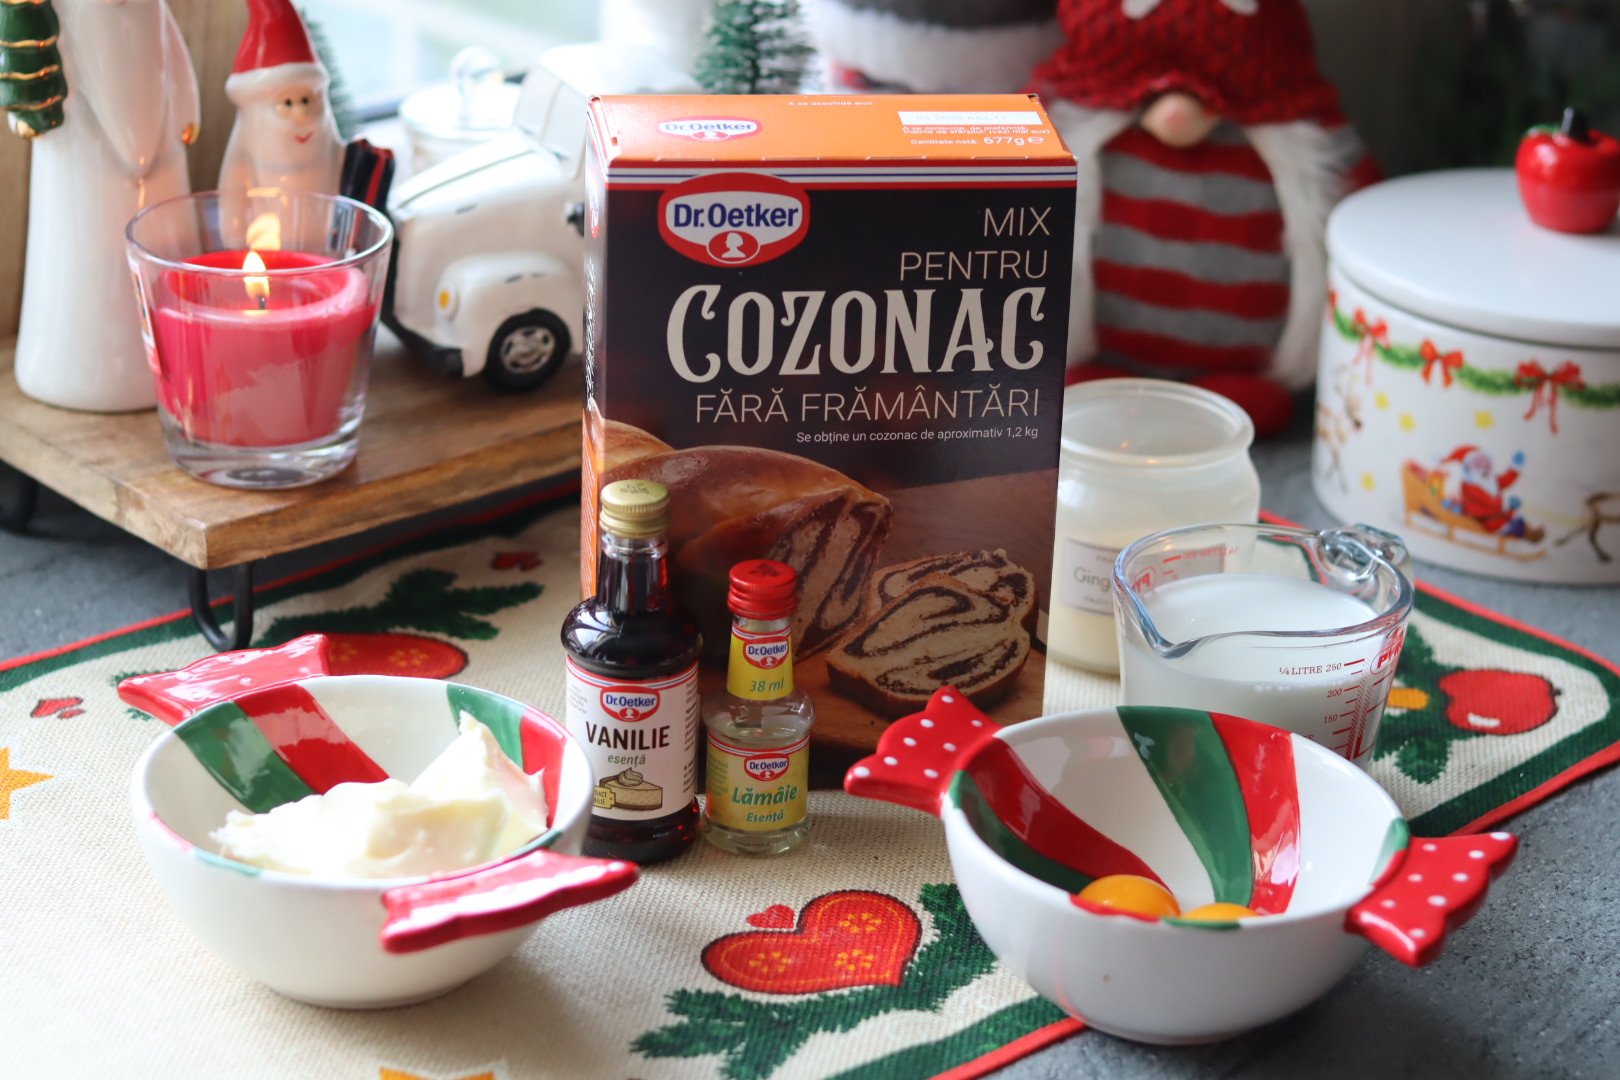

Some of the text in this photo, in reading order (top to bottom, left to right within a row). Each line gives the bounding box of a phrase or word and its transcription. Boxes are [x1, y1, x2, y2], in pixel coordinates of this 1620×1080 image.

[983, 136, 1025, 146] 677g
[673, 203, 799, 228] Dr.Oetker
[983, 206, 1052, 237] MIX
[900, 249, 1048, 281] PENTRU
[666, 284, 1046, 384] COZONAC
[696, 383, 1039, 423] FĂRĂ FRĂMÂNTĂRI
[796, 431, 812, 443] Se
[852, 432, 867, 442] un
[869, 431, 918, 442] cozonac
[920, 428, 935, 441] de
[937, 427, 1003, 443] aproximativ
[1006, 427, 1022, 440] 1,2
[1025, 425, 1039, 440] kg
[1073, 566, 1111, 593] Ging
[1291, 665, 1323, 675] LITRE
[1325, 662, 1342, 673] 250
[749, 677, 784, 692] 38 ml
[1326, 688, 1343, 699] 200
[1323, 714, 1338, 724] 150
[585, 720, 671, 751] VANILIE
[732, 784, 798, 806] Lămâie
